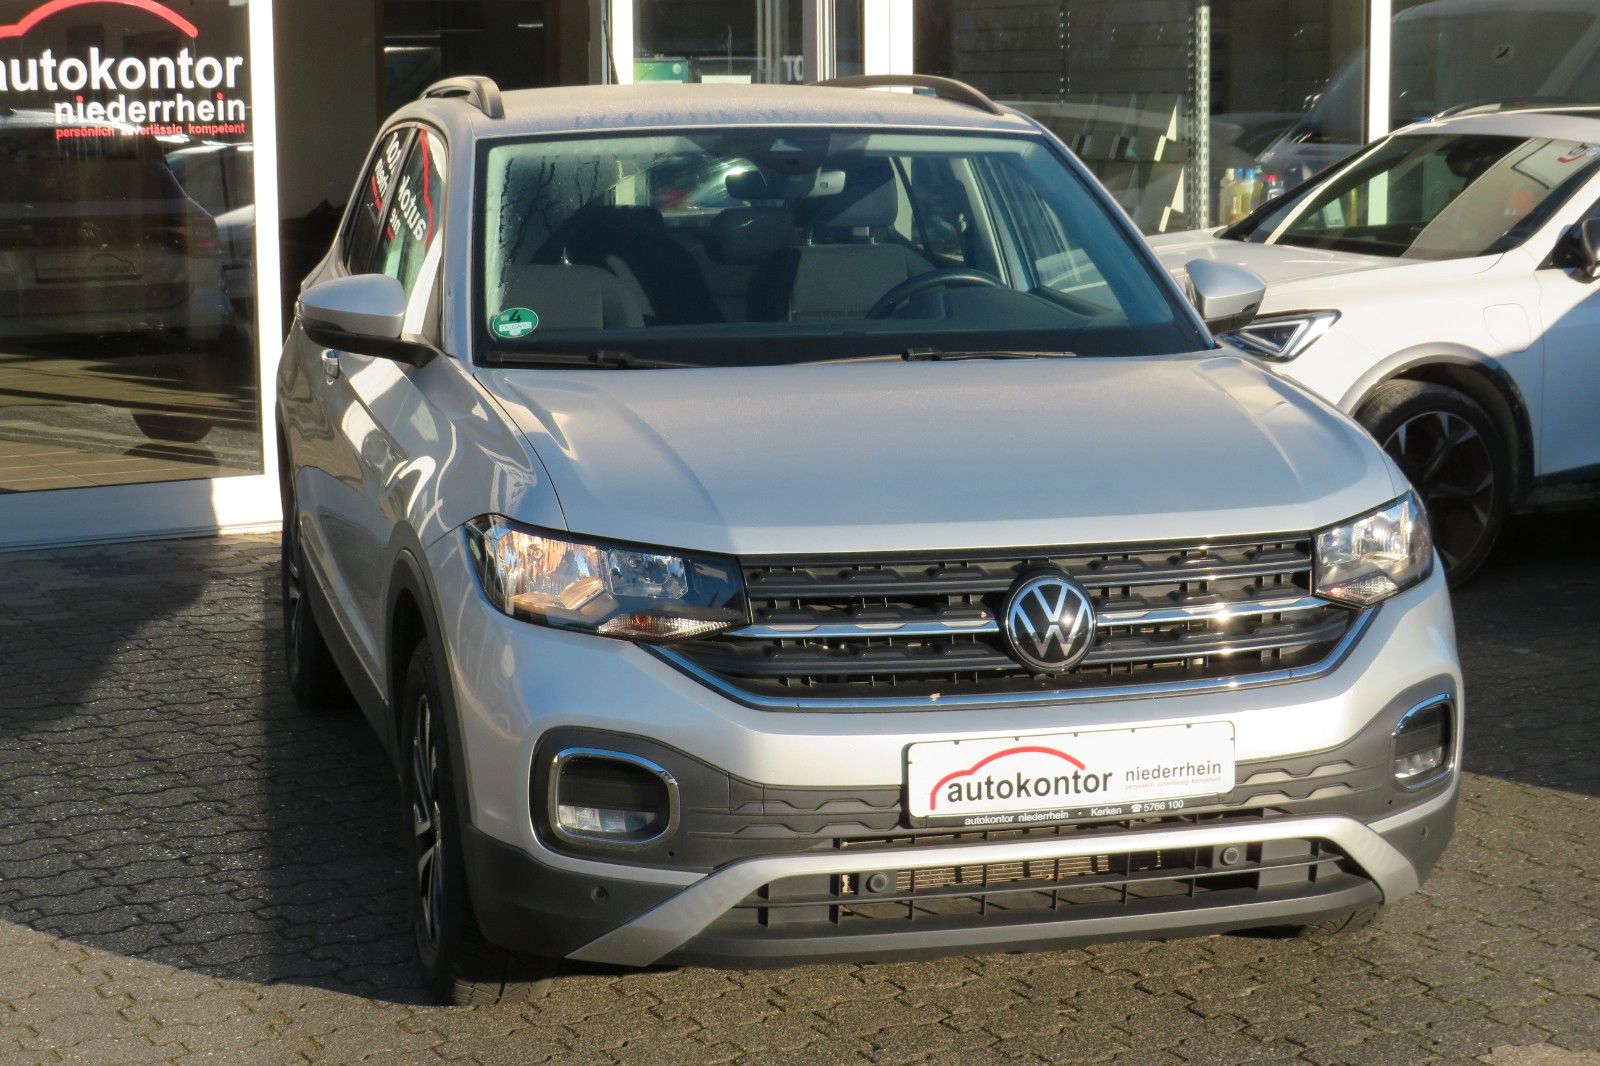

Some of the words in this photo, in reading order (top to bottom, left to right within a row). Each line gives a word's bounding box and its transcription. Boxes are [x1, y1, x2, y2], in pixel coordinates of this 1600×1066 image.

[54, 93, 246, 124] niederrhein
[55, 124, 115, 140] persönlich
[188, 123, 245, 136] kompetent
[509, 310, 522, 322] 4
[947, 770, 1113, 803] autokontor
[1125, 760, 1222, 782] niederrhein
[964, 814, 1014, 826] autokontor
[1018, 810, 1069, 823] niederrhein
[1090, 807, 1122, 817] Kerken
[1143, 802, 1166, 812] 5766
[1168, 799, 1184, 809] 100
